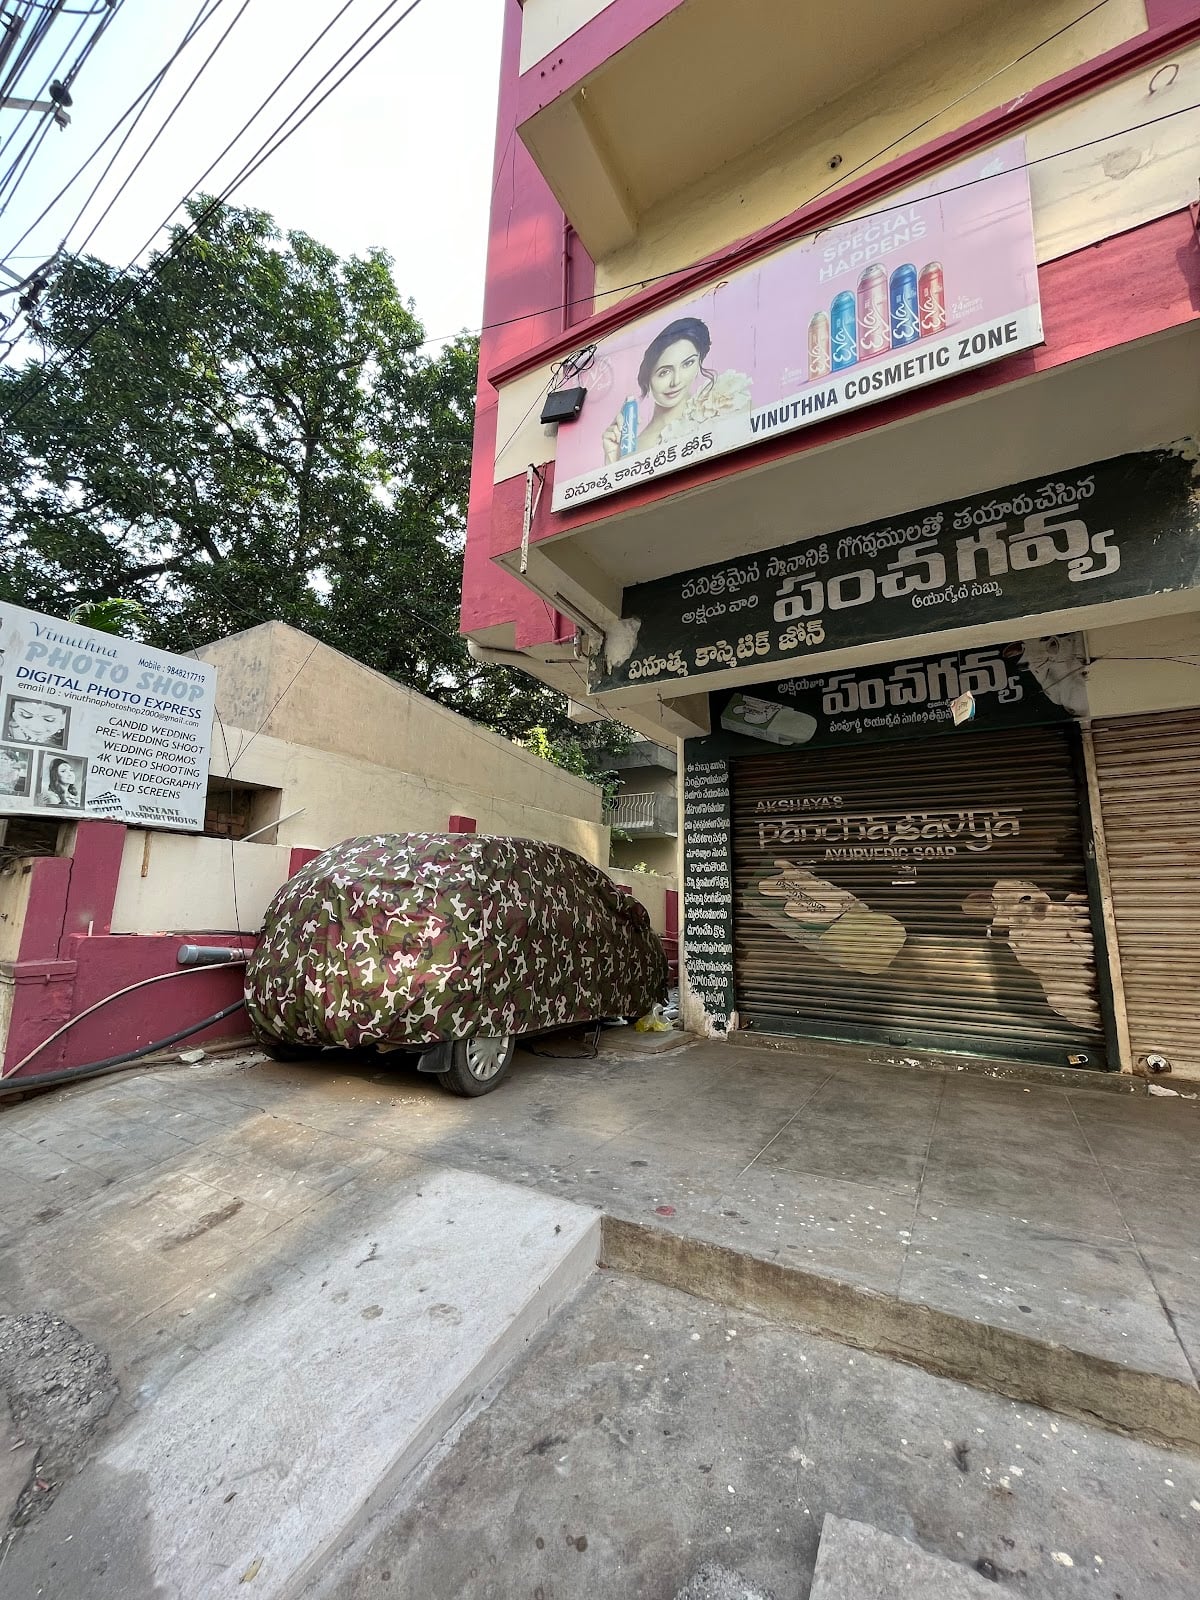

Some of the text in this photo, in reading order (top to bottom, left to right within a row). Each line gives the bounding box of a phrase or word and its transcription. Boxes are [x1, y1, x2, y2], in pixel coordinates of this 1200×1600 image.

[824, 207, 922, 263] SPECIAL
[819, 221, 928, 281] HAPPENS
[750, 320, 1018, 433] VINUTHNA COSMETIC ZONE
[564, 473, 613, 500] వినూత్న
[681, 432, 713, 458] జోన్
[681, 503, 1121, 625] అక్షయ వారి పంచగవ్య
[681, 562, 760, 599] పవిత్రమైన
[766, 543, 830, 578] స్నానానికి
[971, 580, 1003, 597] సబ్బు
[30, 621, 118, 658] Vinuthna
[628, 649, 689, 680] వినూత్న
[778, 620, 826, 651] జోన్
[25, 641, 204, 702] PHOTO SHOP
[138, 658, 161, 671] Mobile
[16, 666, 202, 719] DIGITAL PHOTO EXPRESS
[18, 682, 44, 693] email
[47, 687, 56, 695] ID
[822, 650, 1024, 716] పంచగవ్య
[96, 726, 205, 754] PRE-WEDDING SHOOT
[109, 717, 196, 742] CANDID WEDDING
[97, 753, 200, 778] 4K VIDEO SHOOTING
[103, 741, 196, 765] WEDDING PROMOS
[91, 765, 202, 790] DRONE VIDEOGRAPHY
[114, 782, 180, 799] LED SCREENS
[125, 810, 198, 825] PASSPORT PHOTOS
[139, 805, 180, 816] INSTANT
[755, 795, 844, 814] AKSHAYA'S
[823, 846, 957, 862] AYURVEDIC SOAP
